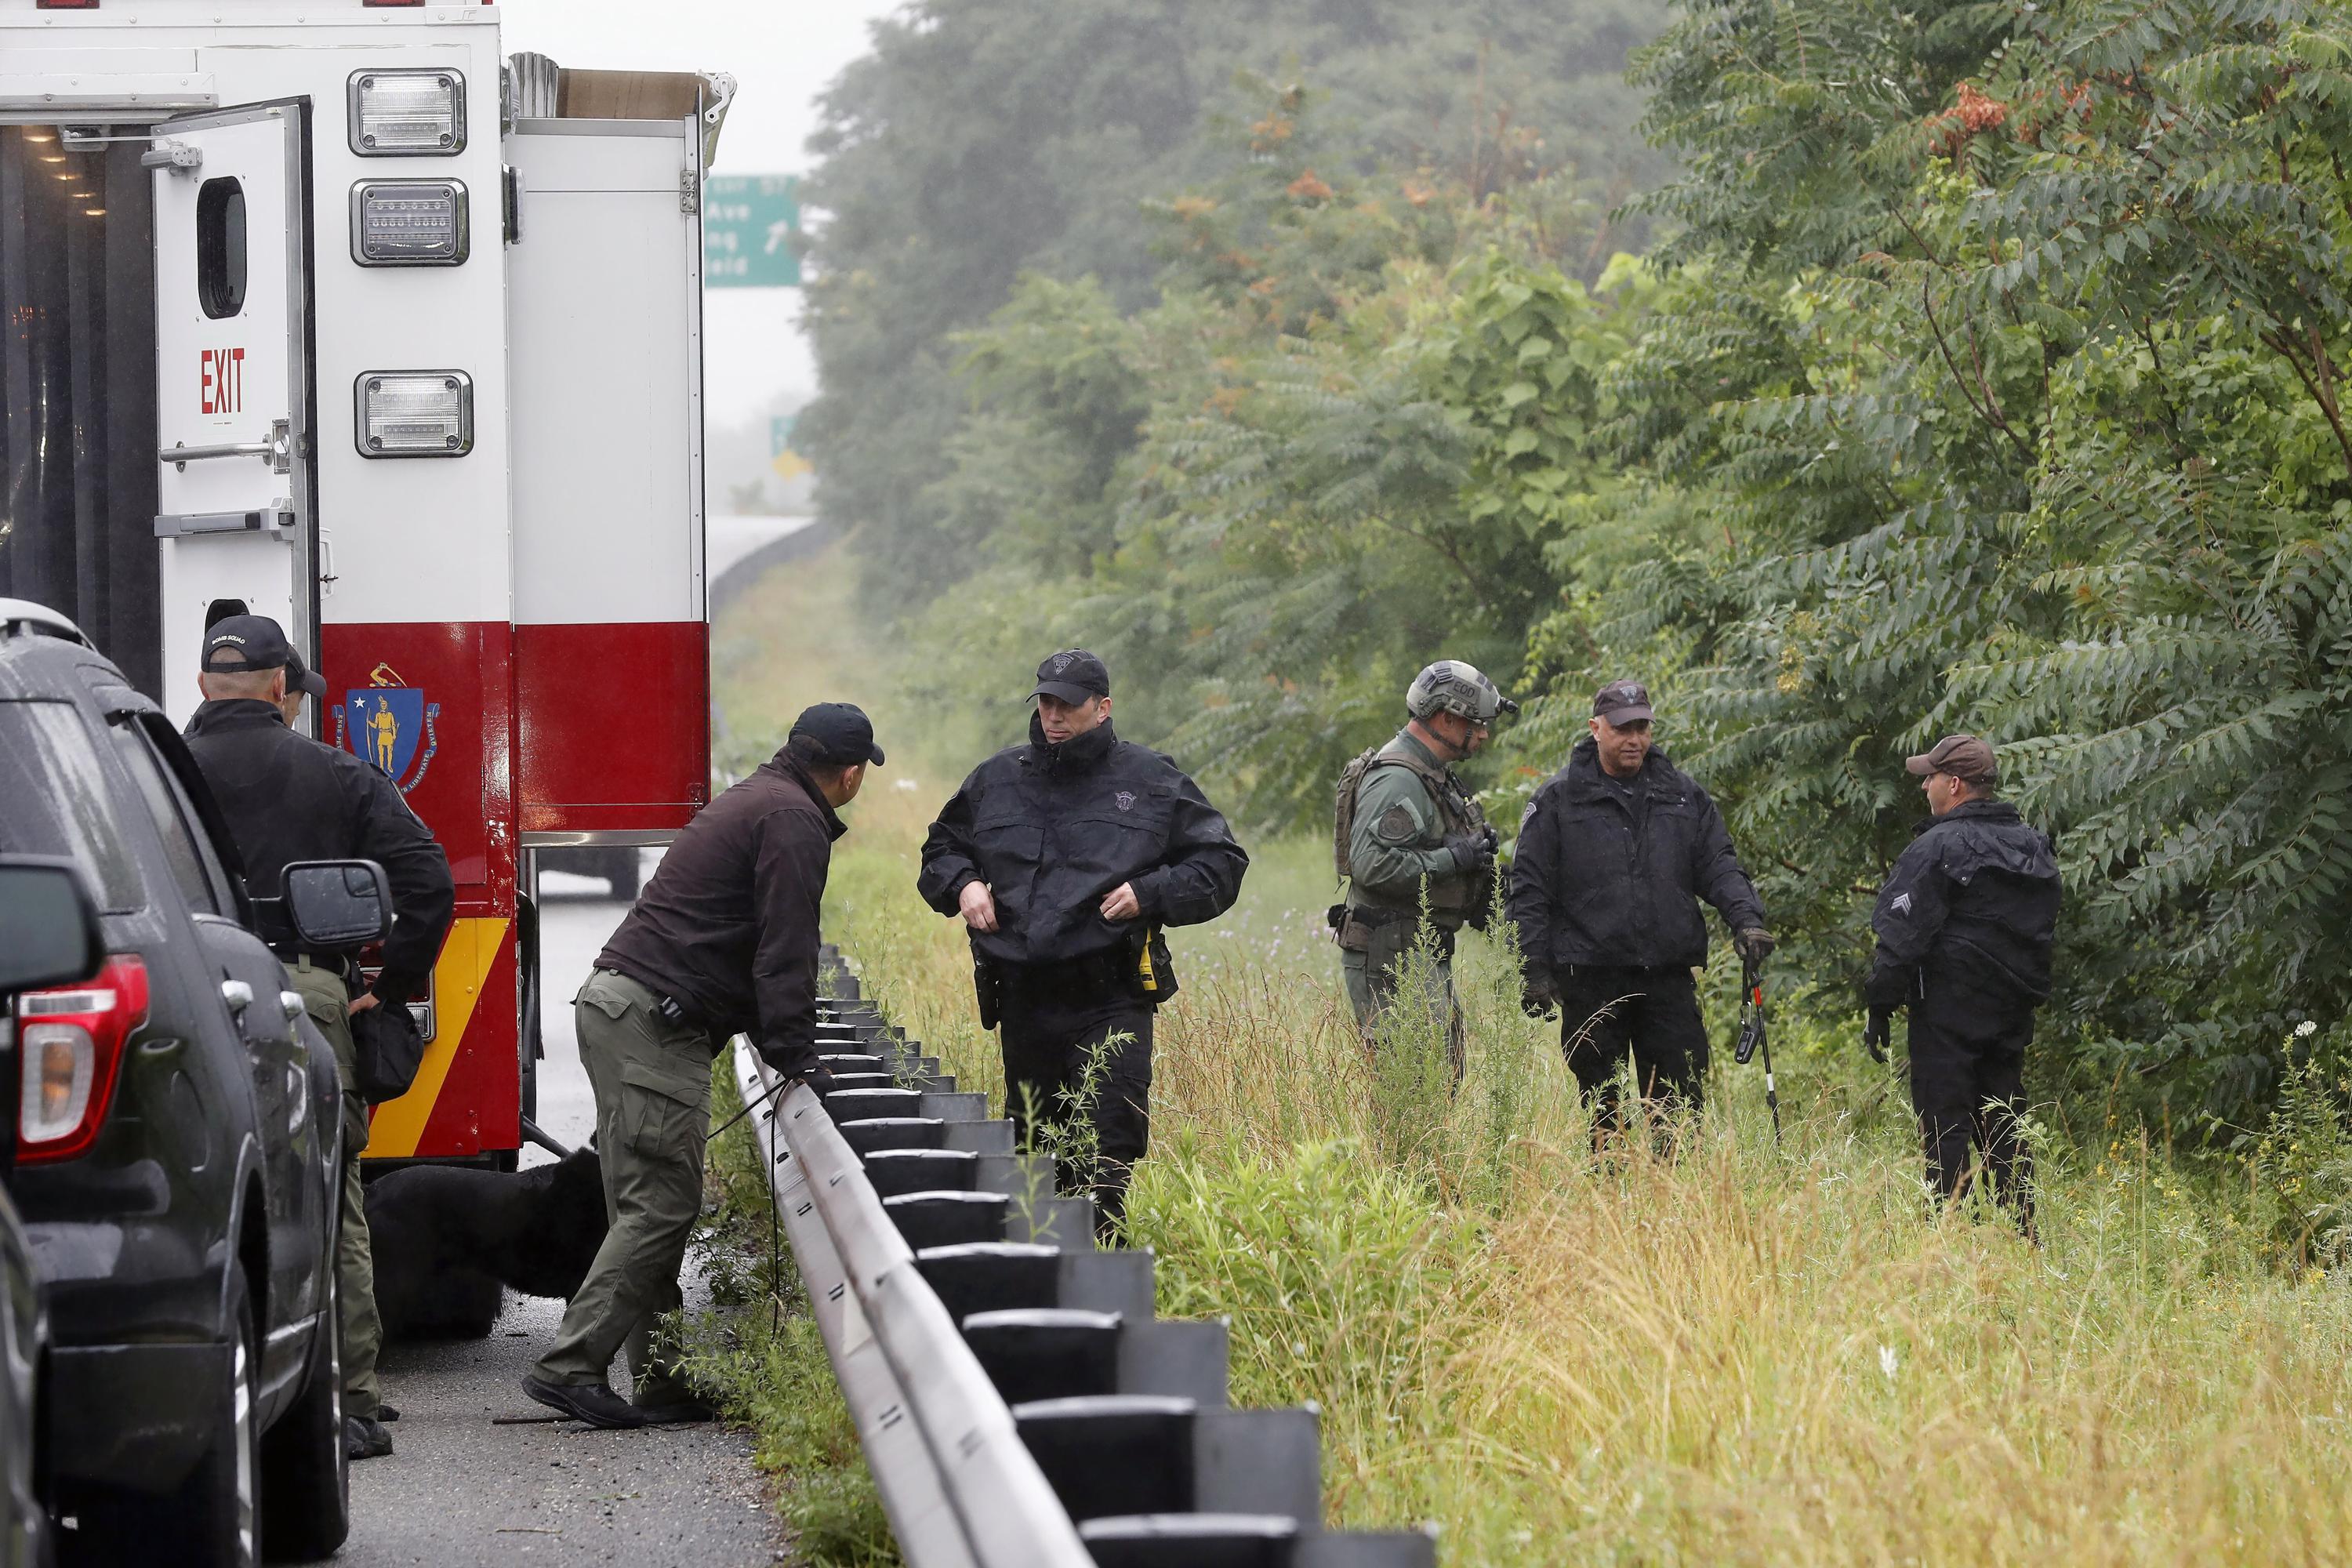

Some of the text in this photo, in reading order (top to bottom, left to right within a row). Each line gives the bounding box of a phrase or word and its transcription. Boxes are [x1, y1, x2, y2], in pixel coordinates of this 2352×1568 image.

[201, 348, 245, 414] EXIT
[212, 635, 245, 644] BOMB SQUAD
[1454, 681, 1474, 698] EOD
[409, 753, 430, 789] LIBERTATE
